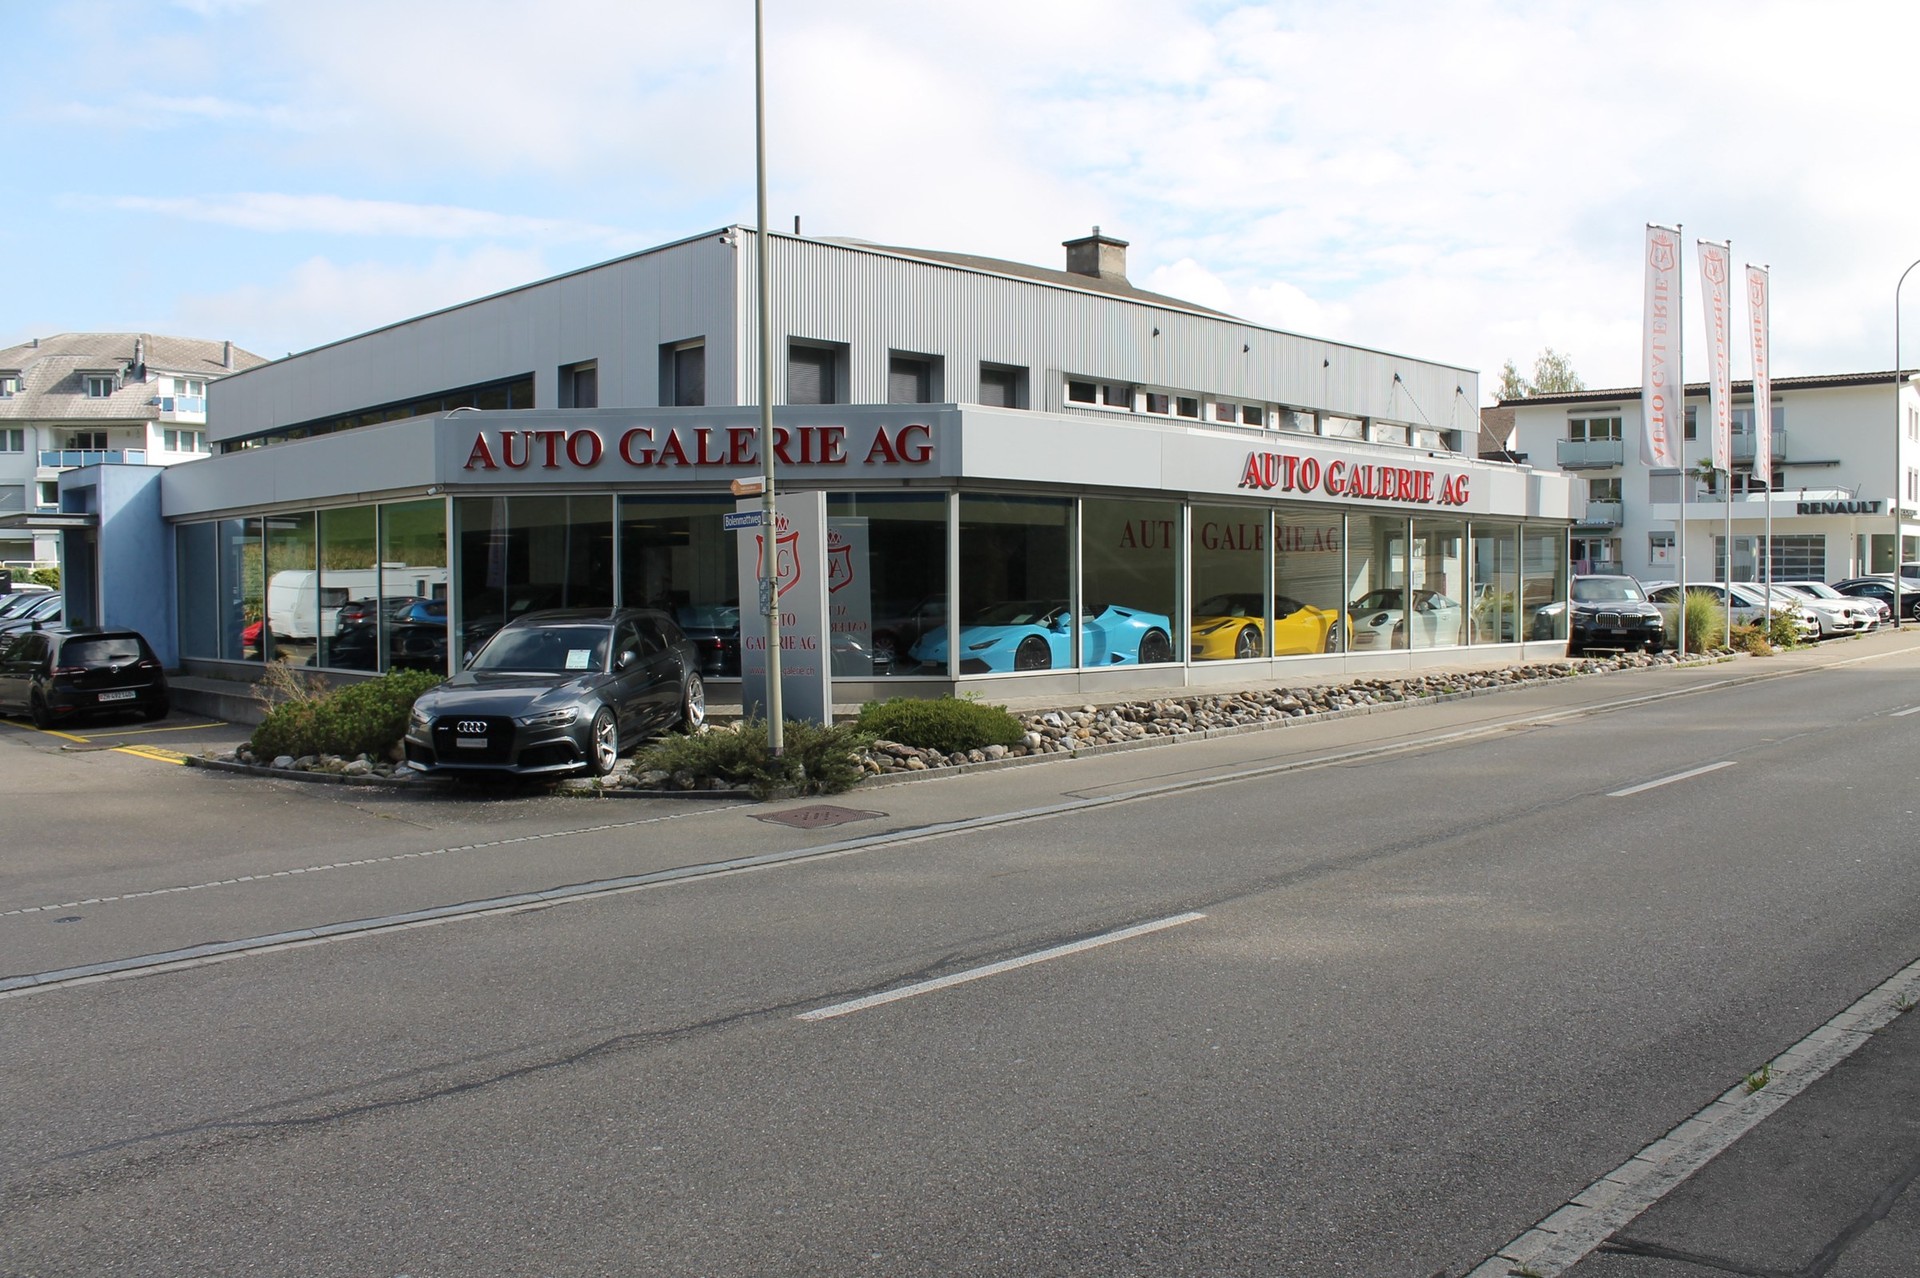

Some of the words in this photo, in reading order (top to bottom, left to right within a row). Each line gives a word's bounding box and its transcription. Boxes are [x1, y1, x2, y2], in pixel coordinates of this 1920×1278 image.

[463, 429, 604, 470] AUTO
[618, 426, 848, 467] GALERIE
[863, 424, 934, 465] AG
[1238, 451, 1321, 493] AUTO
[1324, 460, 1435, 503] GALERIE
[1438, 473, 1470, 506] AG
[1797, 501, 1882, 515] RENAULT
[725, 514, 762, 528] Bolenmattweg
[1119, 520, 1193, 549] AUT
[1201, 522, 1306, 552] GALERIE
[1311, 527, 1339, 553] AG
[746, 636, 796, 650] GARIE
[798, 636, 816, 650] AG
